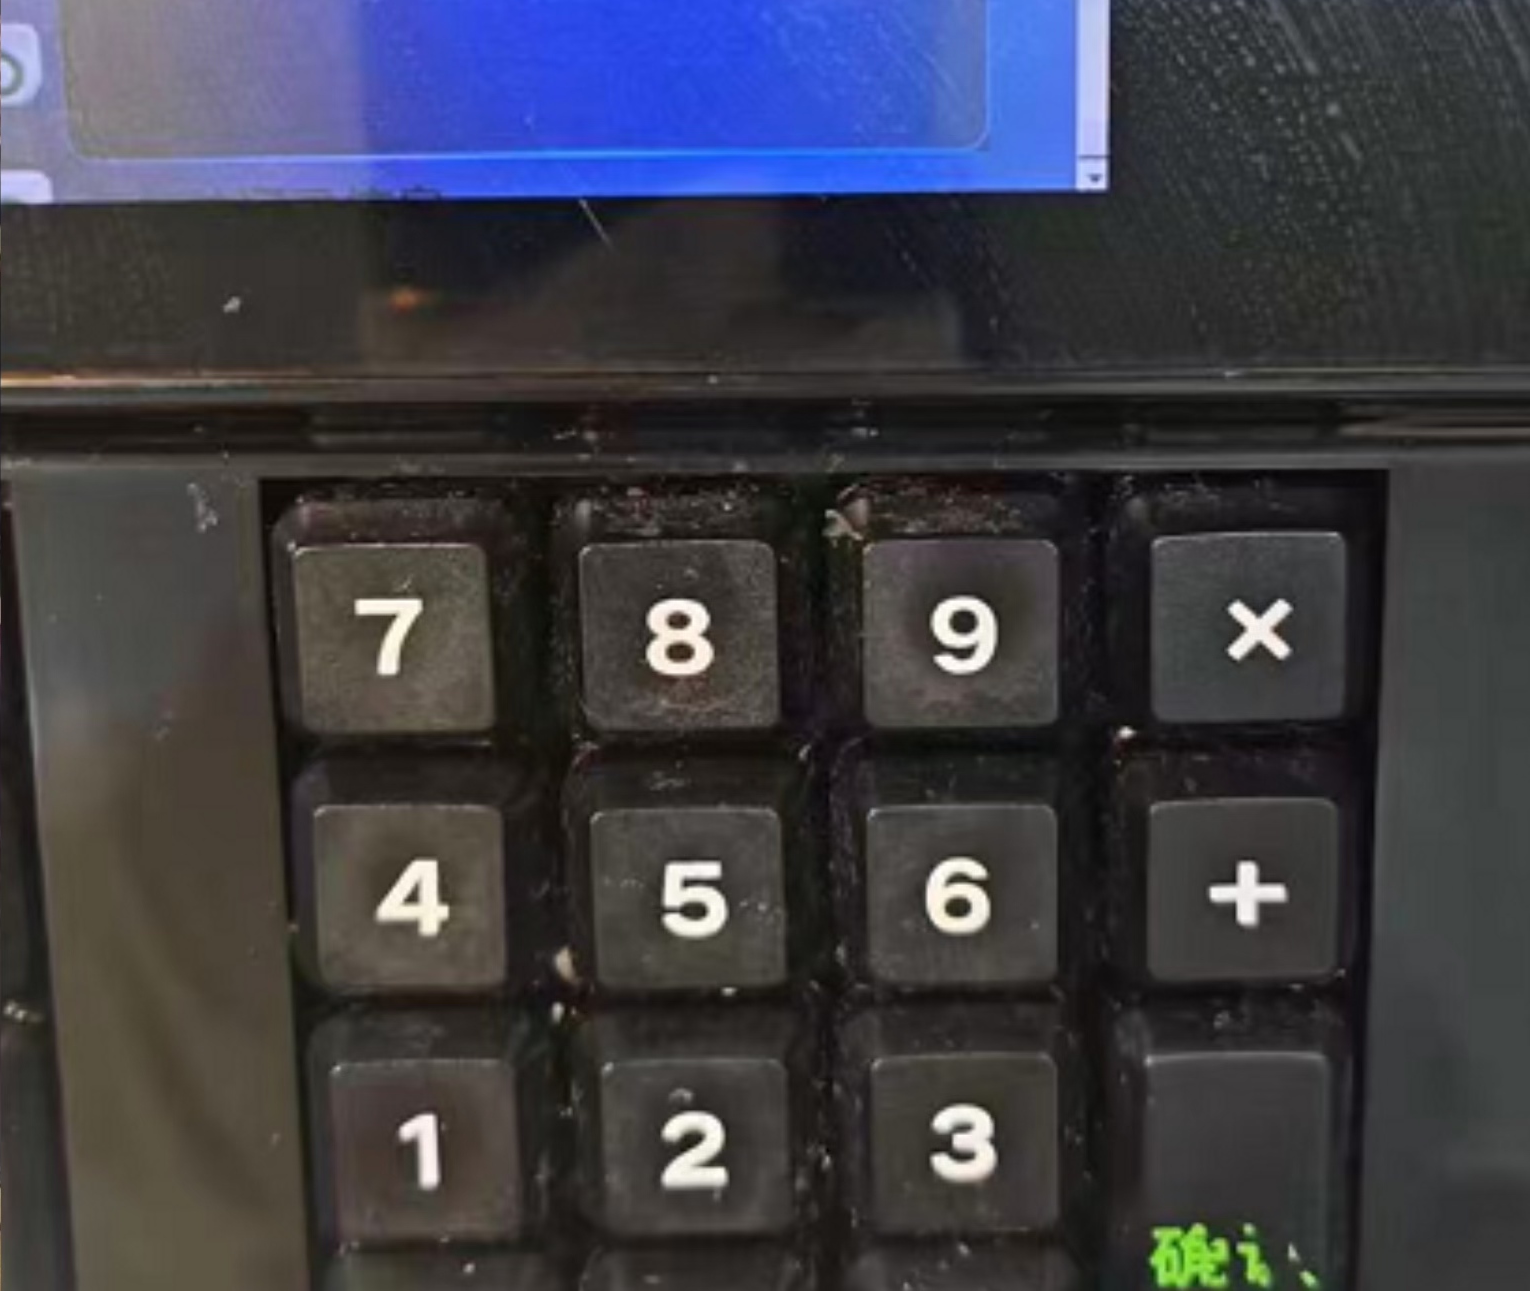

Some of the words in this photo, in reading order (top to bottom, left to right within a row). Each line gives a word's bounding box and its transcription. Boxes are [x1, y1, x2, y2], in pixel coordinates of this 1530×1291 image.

[353, 597, 424, 677] 7
[645, 597, 715, 677] 8
[930, 595, 998, 676] 9
[375, 858, 451, 938] 4
[662, 860, 729, 939] 5
[924, 856, 991, 935] 6
[398, 1113, 441, 1190] 1
[660, 1110, 729, 1188] 2
[930, 1103, 998, 1182] 3
